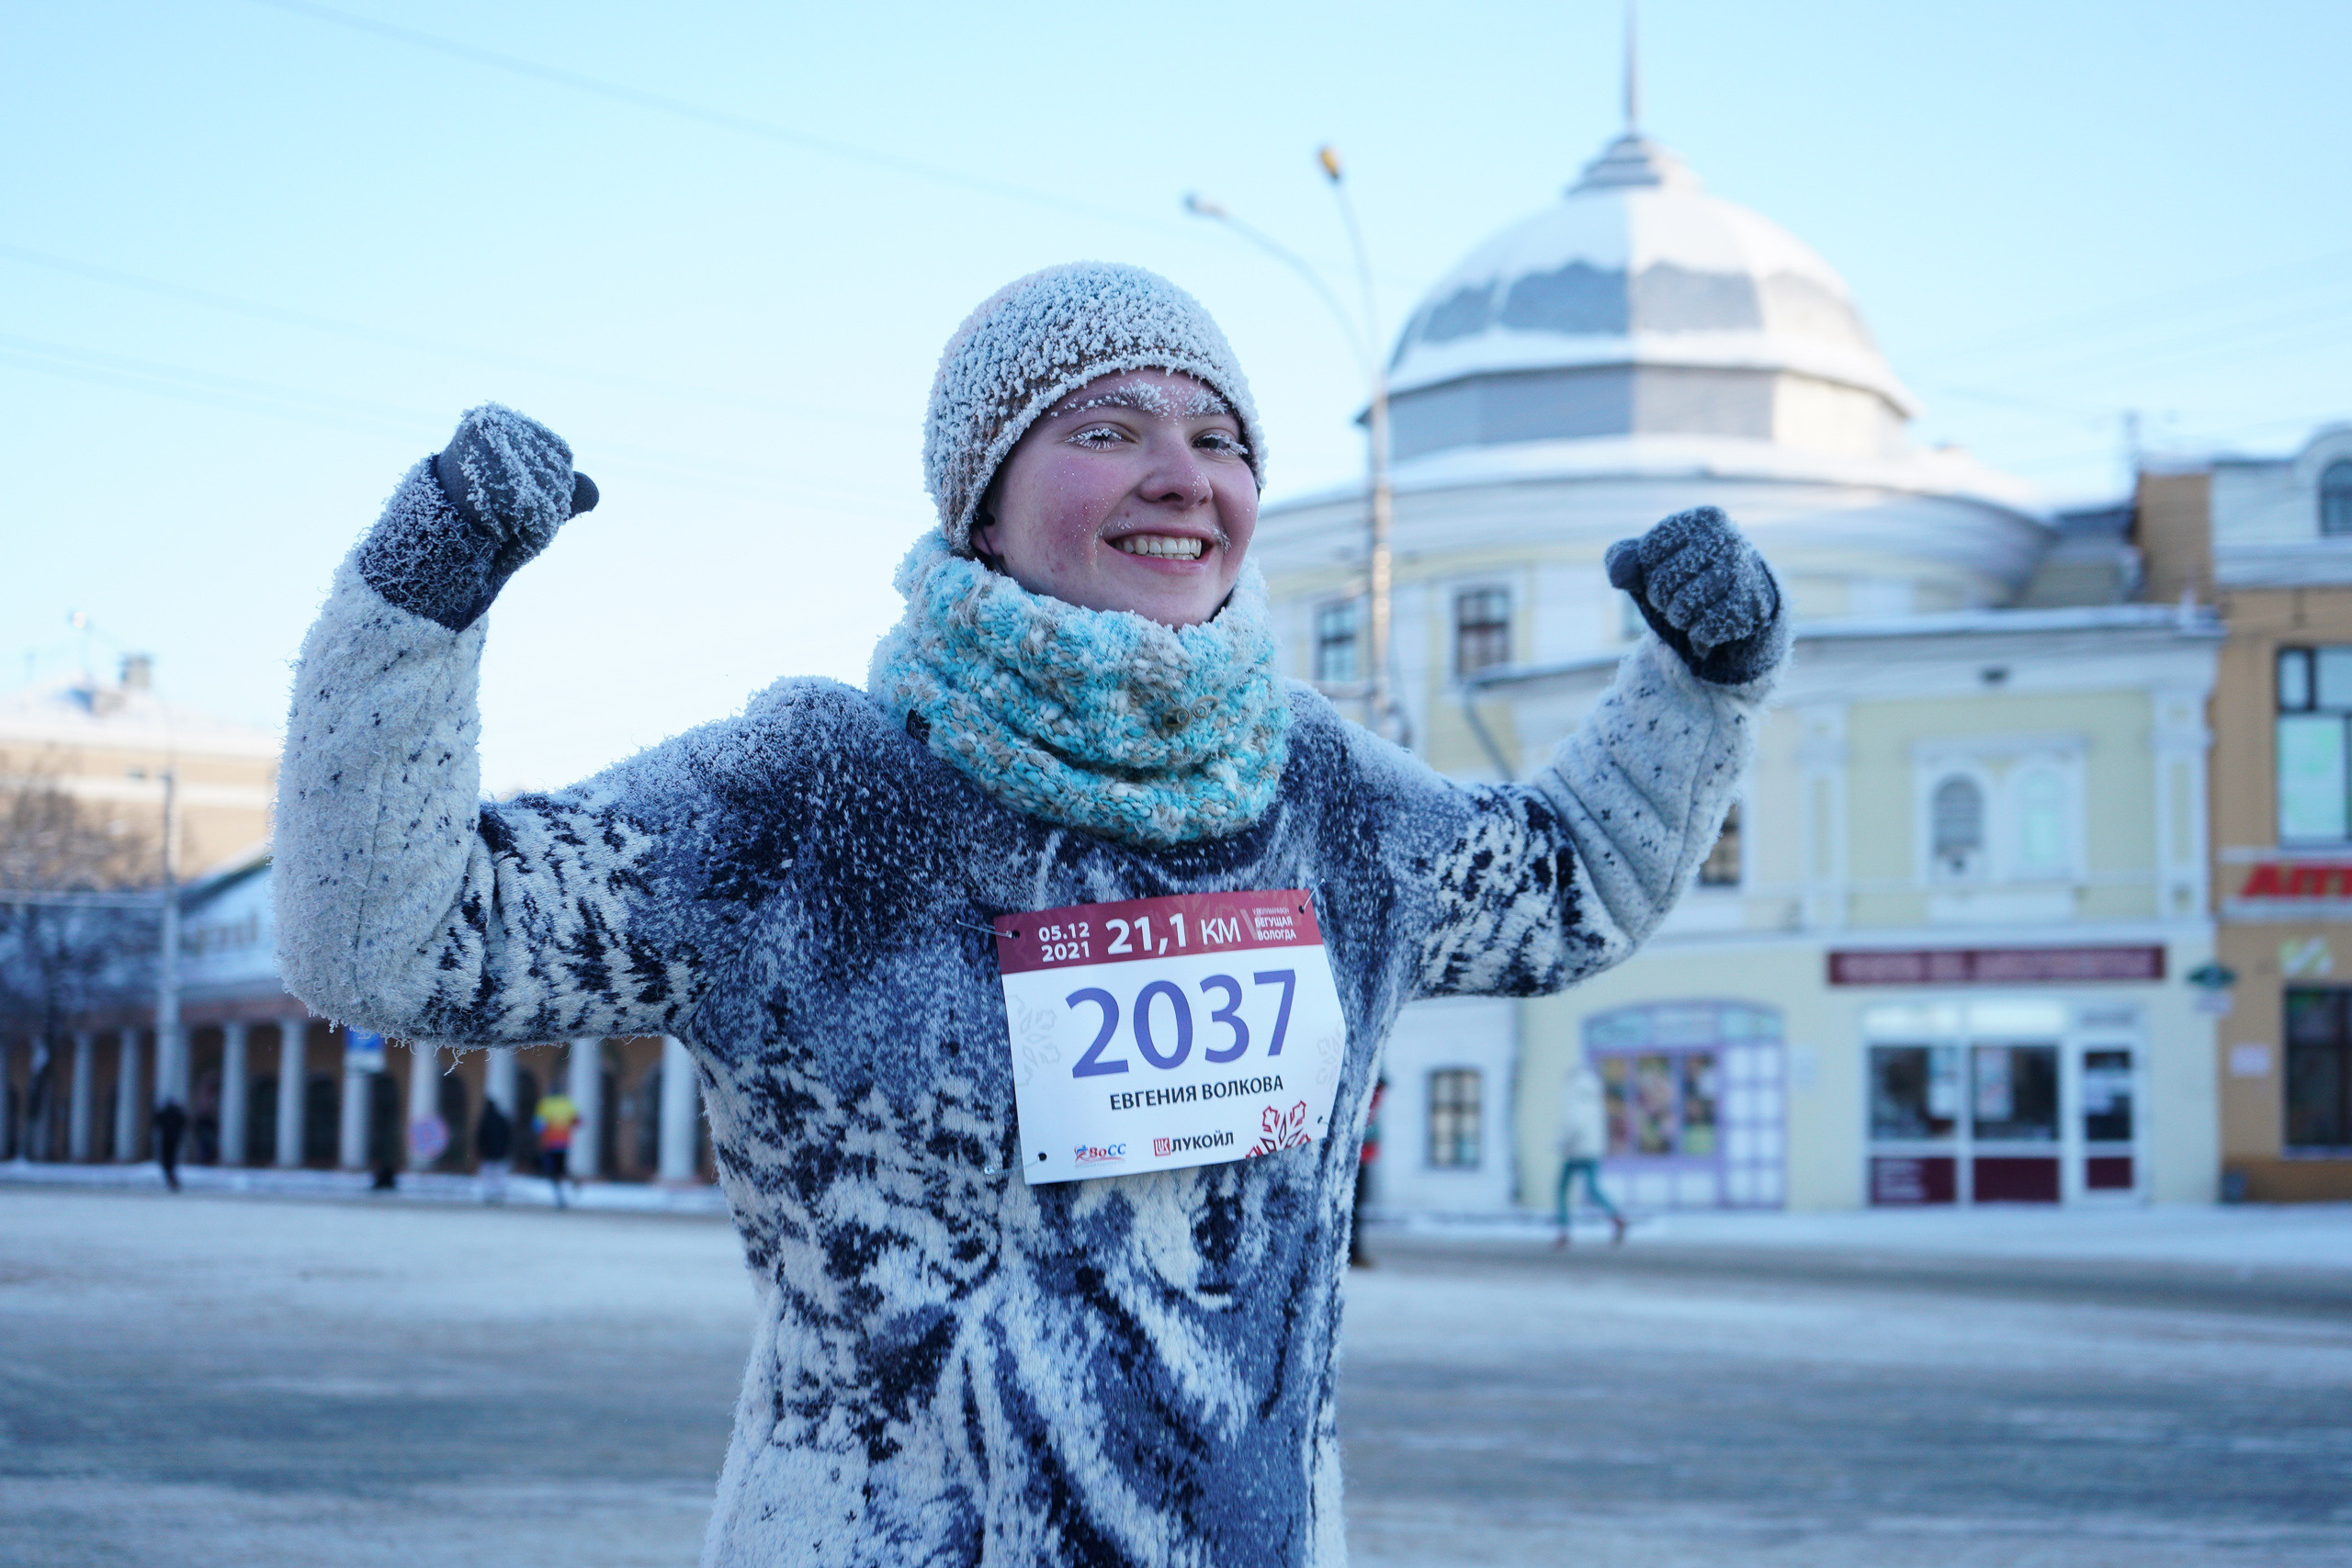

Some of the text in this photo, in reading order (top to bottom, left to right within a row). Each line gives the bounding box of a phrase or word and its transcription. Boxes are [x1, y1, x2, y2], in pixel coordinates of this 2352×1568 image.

[1038, 921, 1090, 942] 05.12
[1105, 913, 1241, 955] 21,1 КМ
[1257, 929, 1296, 941] ВОЛОГДА
[1041, 941, 1091, 963] 2021
[1065, 969, 1295, 1078] 2037
[1110, 1075, 1284, 1111] ЕВГЕНИЯ ВОЛКОВА
[1171, 1131, 1234, 1152] ЛУКОЙЛ
